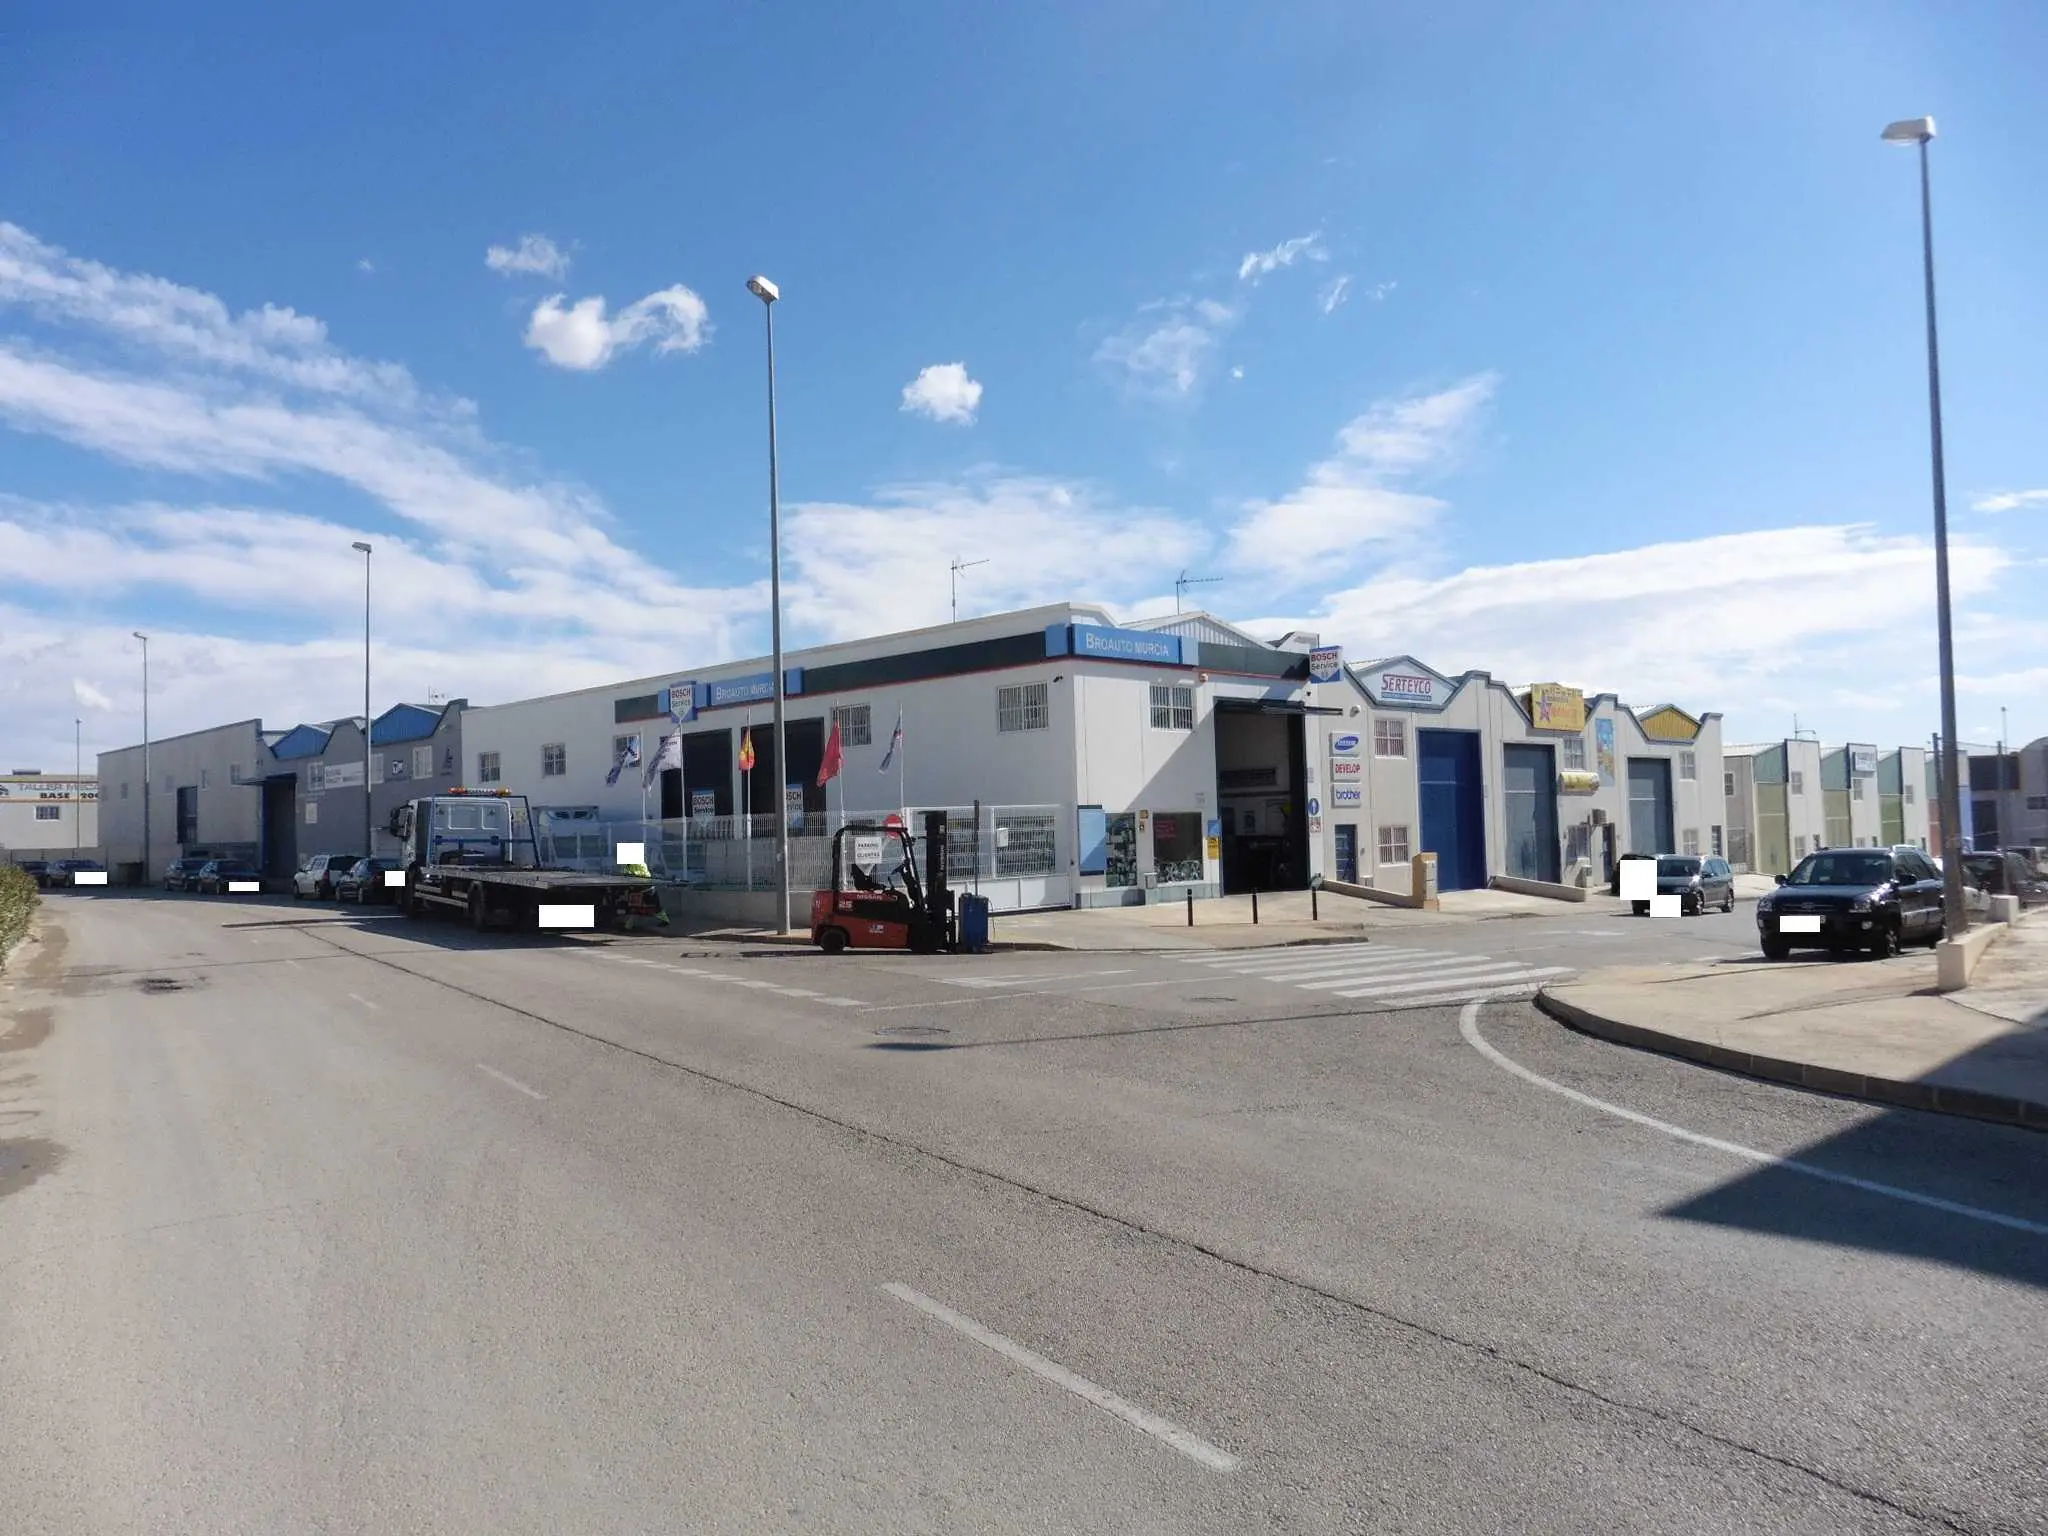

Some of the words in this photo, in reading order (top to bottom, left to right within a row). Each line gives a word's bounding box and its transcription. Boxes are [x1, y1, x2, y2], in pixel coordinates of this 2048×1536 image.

[1086, 632, 1133, 651] BROAUTO
[1135, 641, 1170, 657] MURCIA
[1311, 652, 1338, 661] BOSCH
[1311, 662, 1338, 671] Service
[1381, 674, 1431, 694] SERTEYCO
[671, 688, 691, 698] BOSCH
[1335, 763, 1361, 774] DEVELOP
